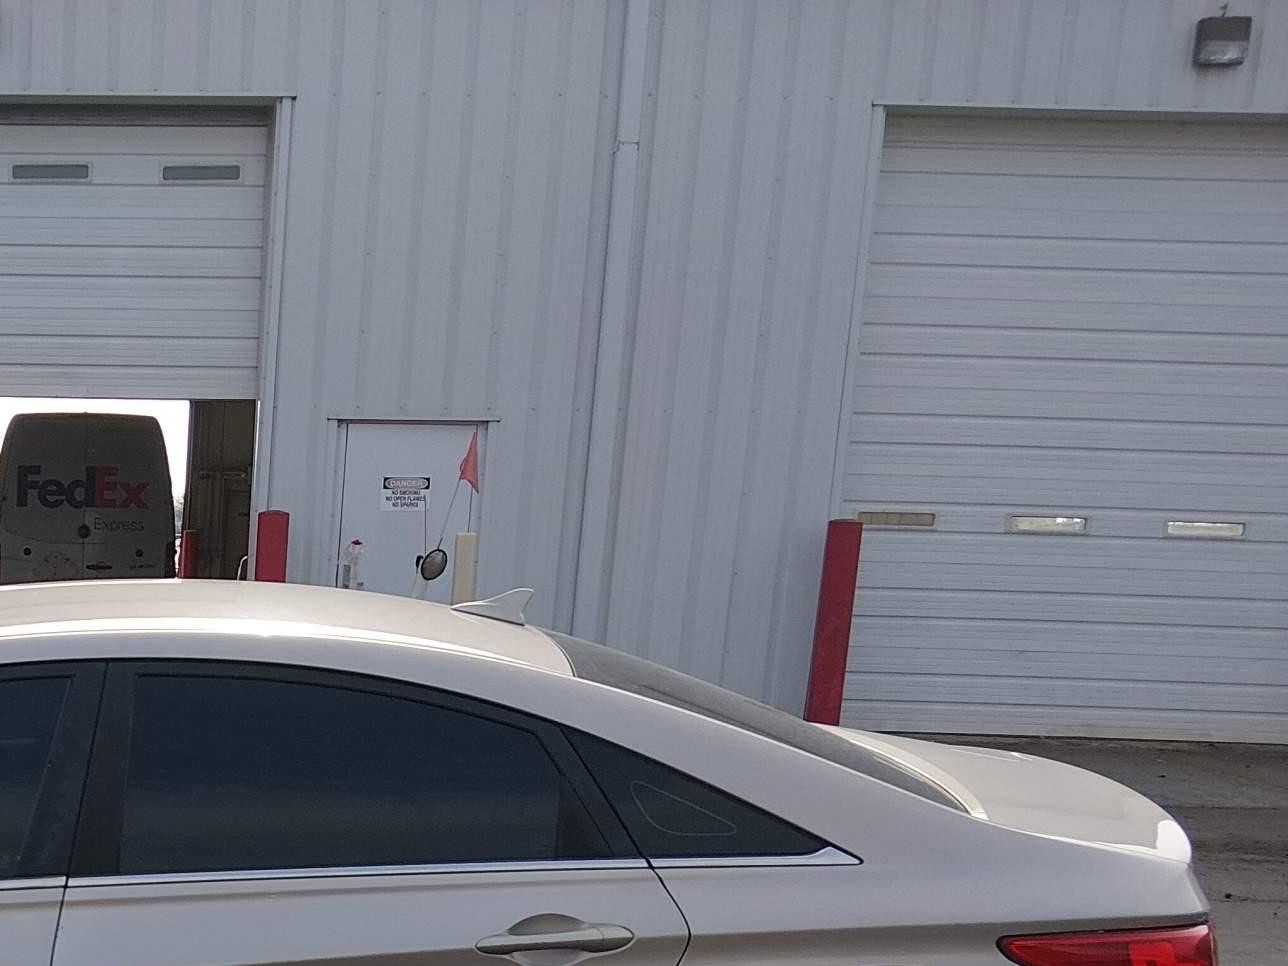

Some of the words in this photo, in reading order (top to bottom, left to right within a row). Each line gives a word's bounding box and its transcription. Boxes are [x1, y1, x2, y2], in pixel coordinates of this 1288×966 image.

[16, 464, 150, 510] FedEx
[390, 479, 423, 487] DANGER
[94, 517, 144, 532] Express
